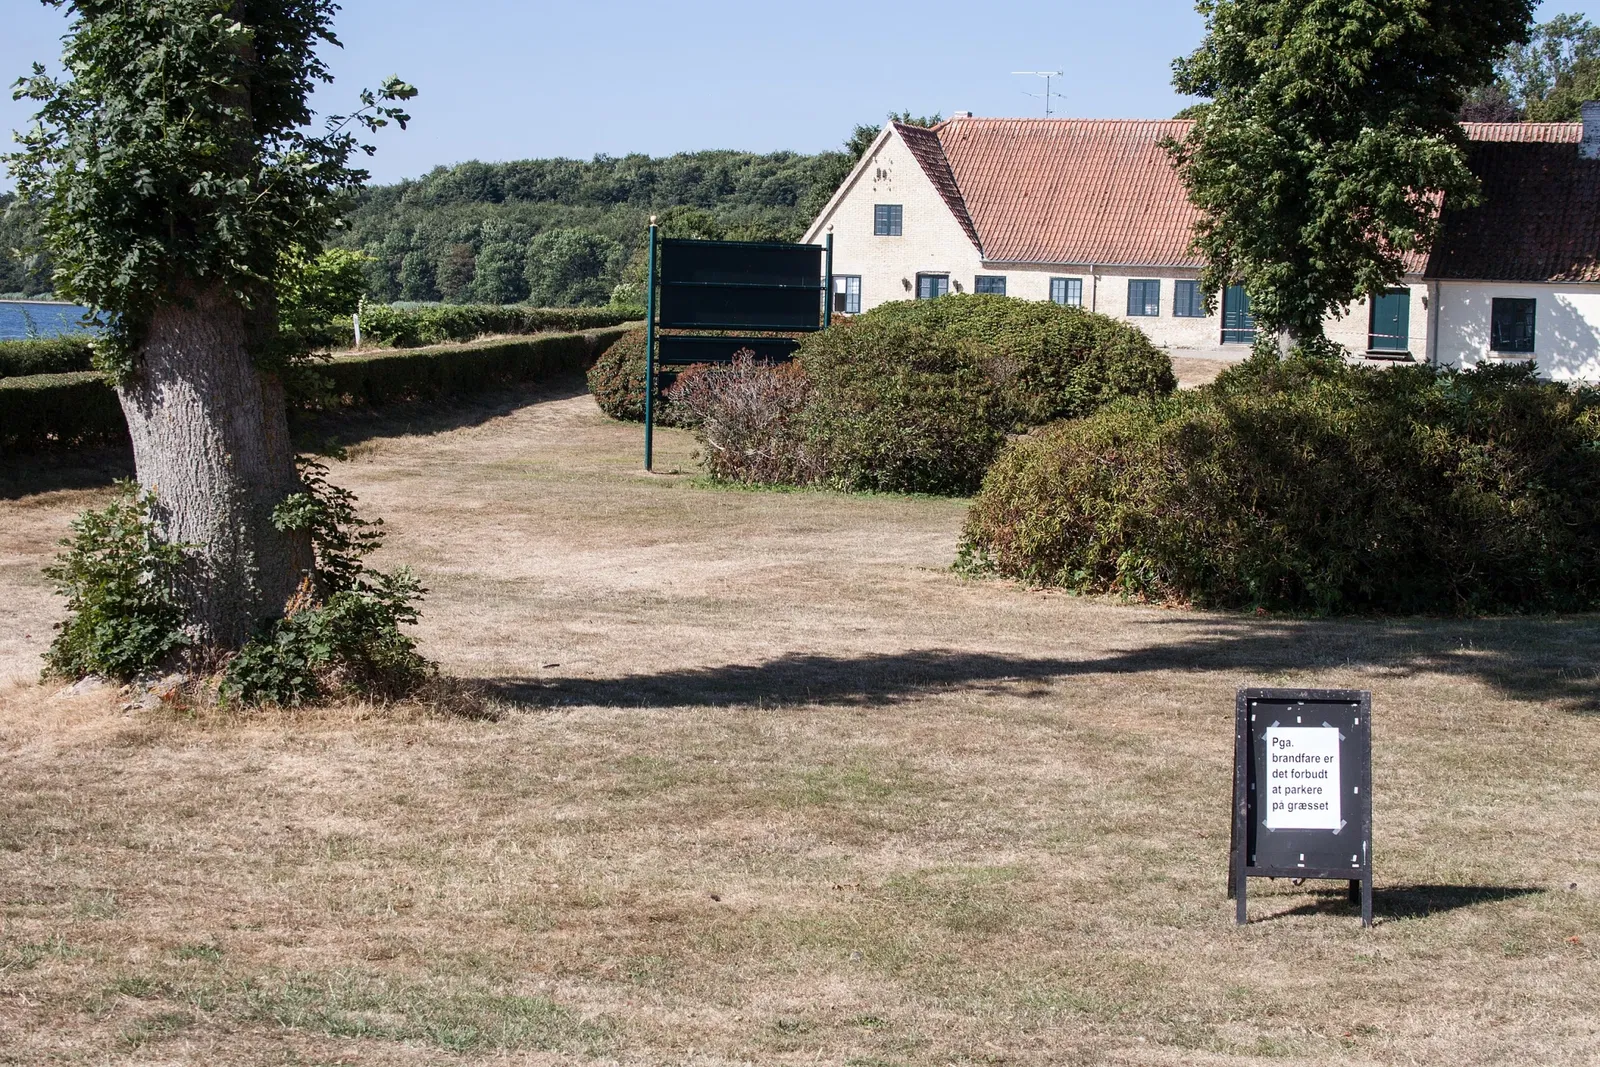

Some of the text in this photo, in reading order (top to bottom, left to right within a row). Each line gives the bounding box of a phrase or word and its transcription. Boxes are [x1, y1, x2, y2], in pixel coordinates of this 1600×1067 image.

[1272, 737, 1294, 749] Pga.
[1272, 753, 1334, 763] brandfare er
[1272, 768, 1328, 779] det forbudt
[1272, 785, 1323, 796] at parkere
[1272, 800, 1329, 812] på græsset
